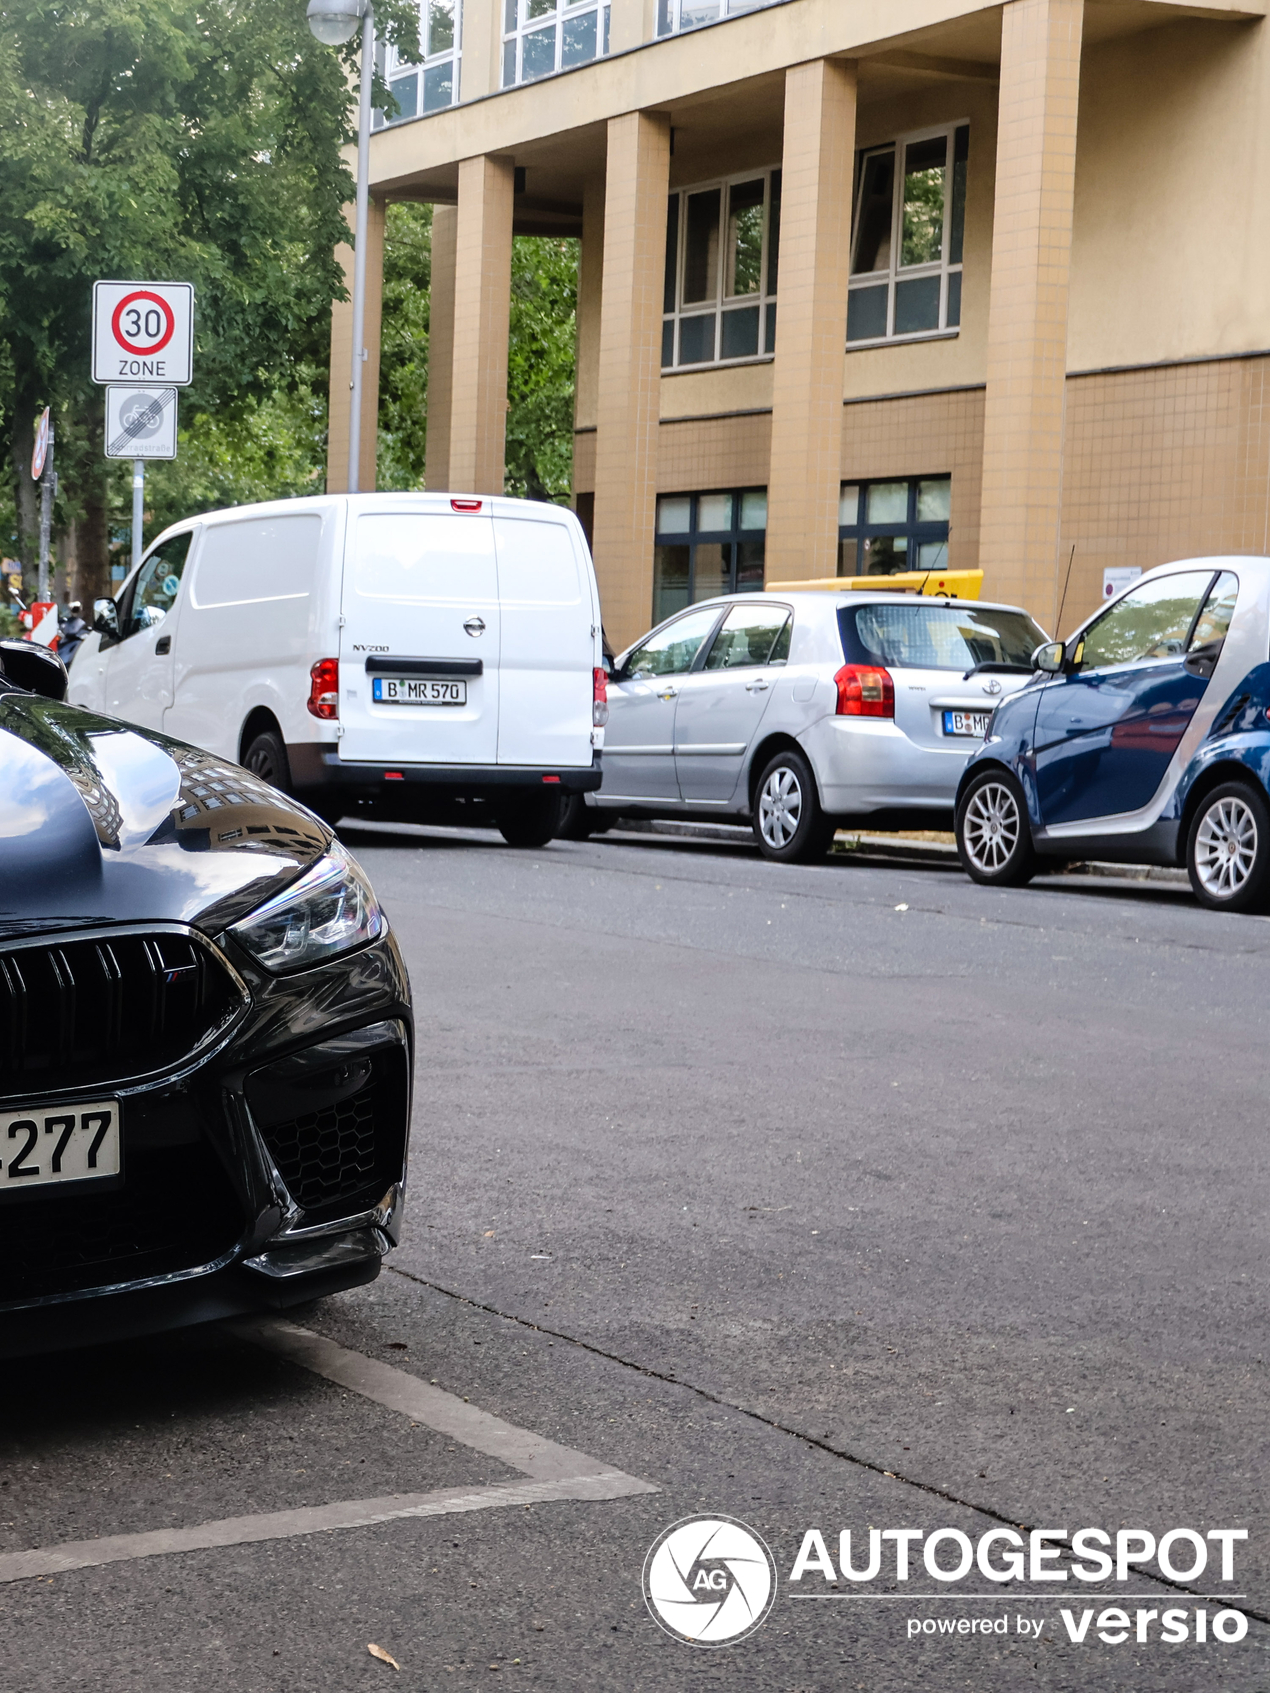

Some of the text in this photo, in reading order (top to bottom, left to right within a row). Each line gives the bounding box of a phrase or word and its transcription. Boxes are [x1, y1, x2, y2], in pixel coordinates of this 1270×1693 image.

[124, 309, 161, 338] 30
[119, 360, 166, 376] ZONE
[112, 444, 171, 453] rradstraße
[353, 644, 389, 652] NV200
[388, 682, 459, 699] B MR 570
[954, 715, 964, 729] B
